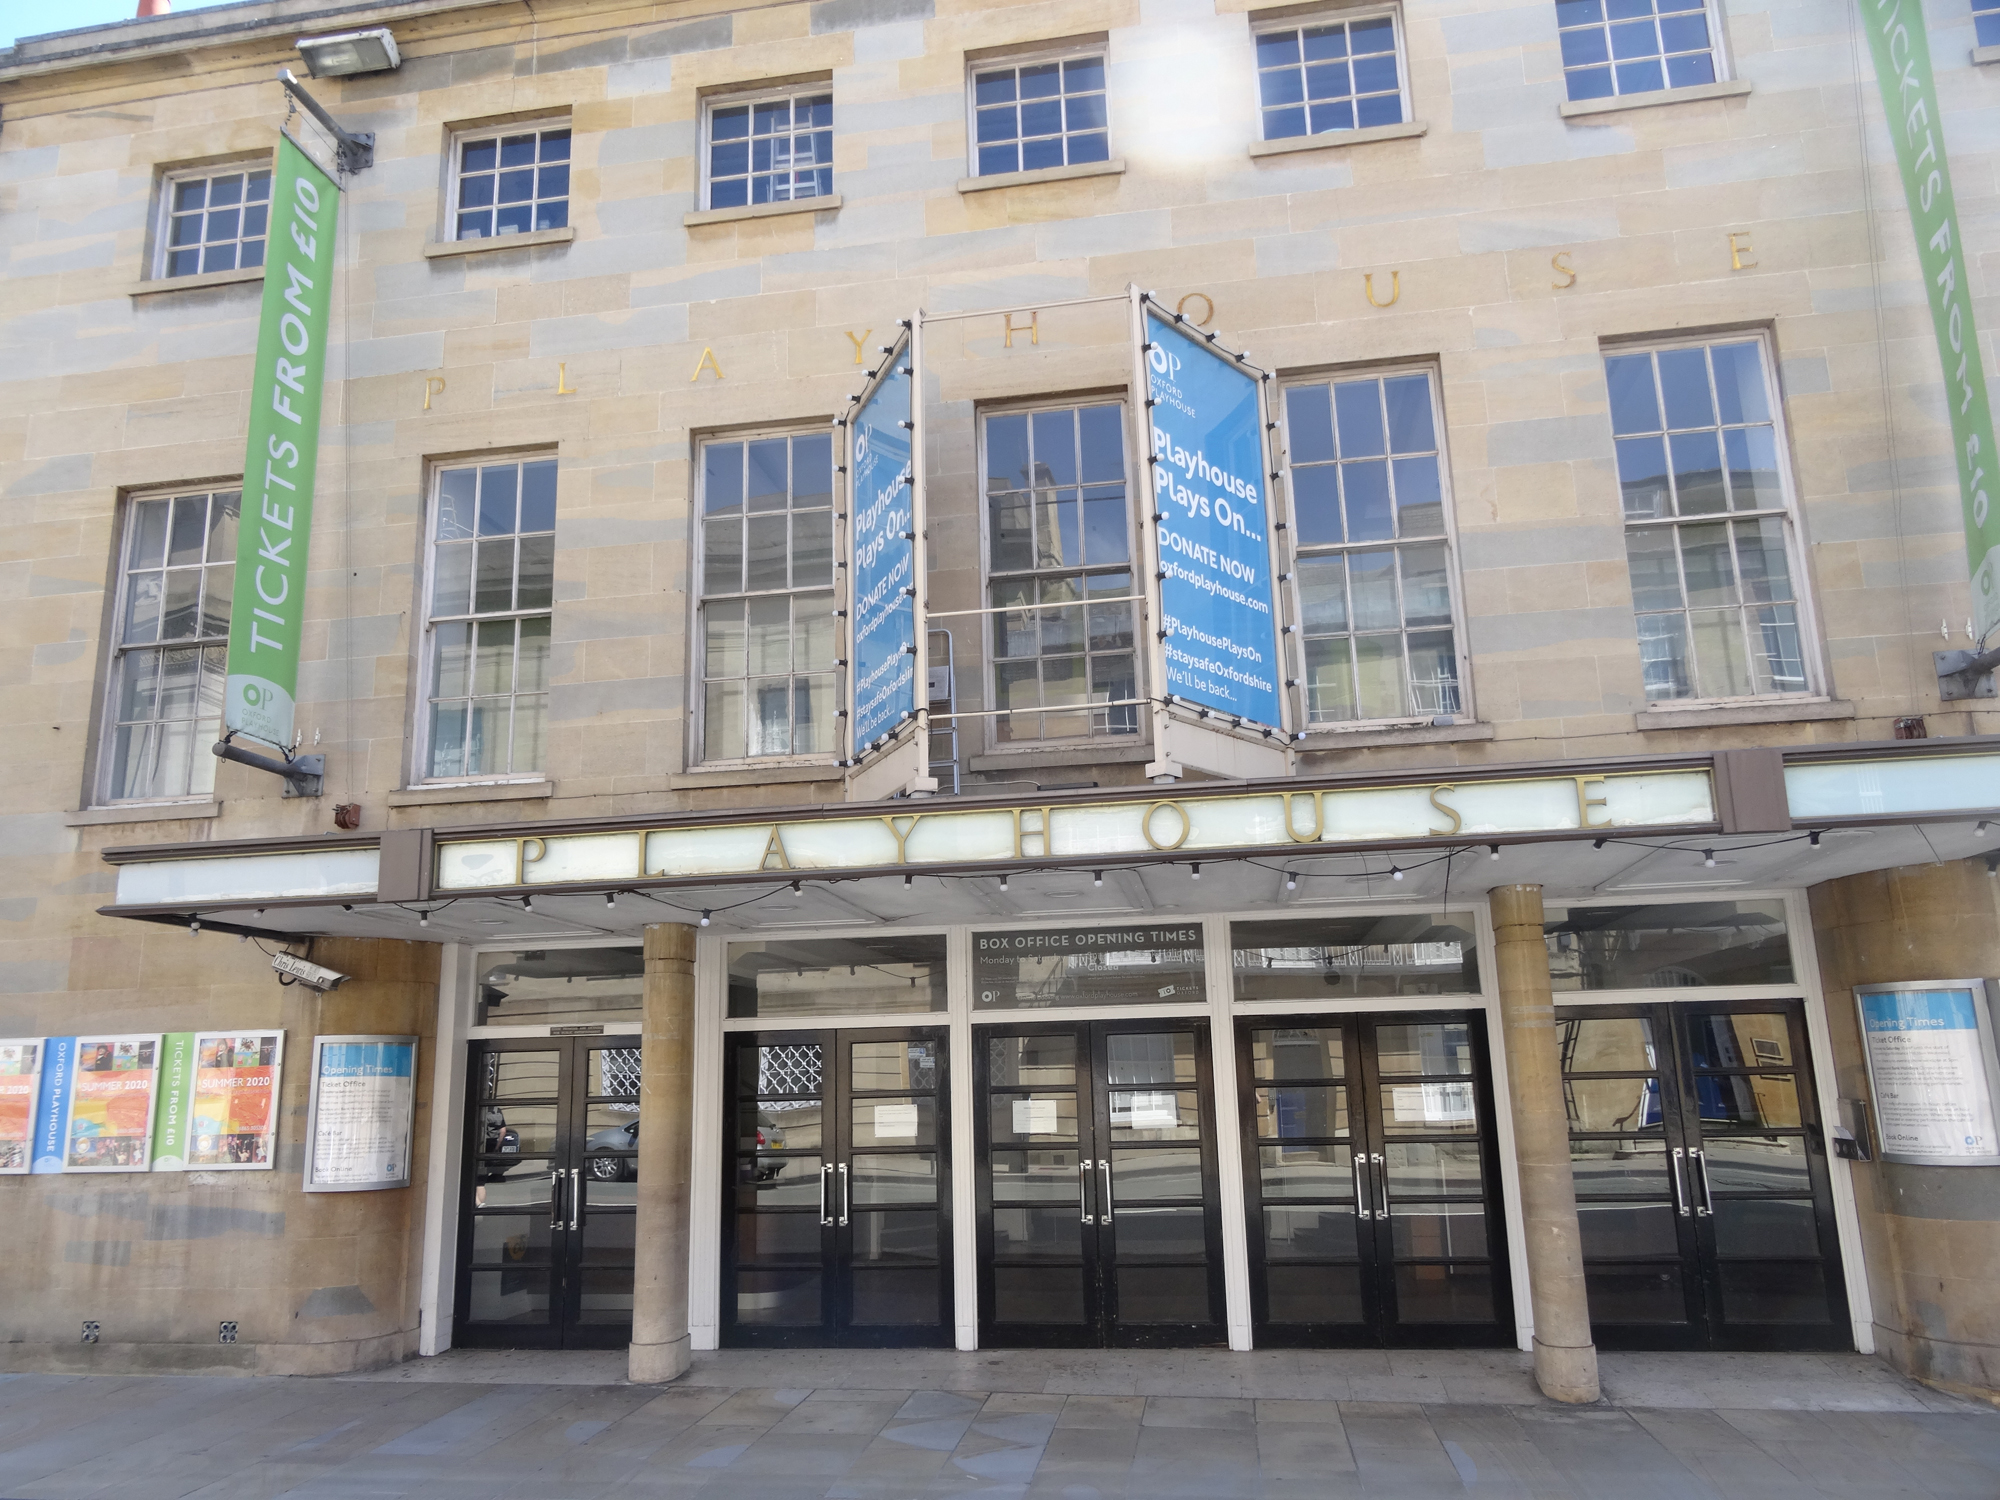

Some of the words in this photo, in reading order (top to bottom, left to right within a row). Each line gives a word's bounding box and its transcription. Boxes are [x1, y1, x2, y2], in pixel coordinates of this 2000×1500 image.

[290, 177, 320, 262] £10
[1877, 0, 1942, 213] ICKETS
[1929, 217, 1973, 415] FROM
[1966, 434, 1989, 528] £10
[423, 231, 1758, 410] PLAYHOUSE
[272, 261, 314, 425] FROM
[1150, 374, 1183, 398] OXFORD
[1151, 385, 1196, 418] PLAYHOUSE
[1153, 426, 1257, 504] Playhouse
[856, 460, 912, 541] Playhouse
[1155, 465, 1211, 519] Plays
[1214, 497, 1262, 542] On...
[250, 433, 299, 653] TICKETS
[856, 530, 885, 576] Plays
[1158, 526, 1218, 569] DONATE
[1220, 554, 1255, 585] NOW
[857, 575, 887, 621] DONATE
[888, 552, 910, 590] NOW
[1160, 560, 1269, 614] oxfordplayhouse.com
[1163, 613, 1262, 664] #PlayhousePlaysOn
[1164, 642, 1272, 693] #staysafeOxfordshire
[1166, 664, 1193, 688] We'll
[1194, 675, 1207, 692] be
[1208, 679, 1238, 702] back...
[241, 708, 272, 724] OXFORD
[241, 717, 280, 737] PLAYHOUSE
[870, 717, 877, 729] be
[515, 775, 1613, 886] PLAYHOUSE
[979, 937, 1010, 950] BOX
[1014, 934, 1070, 948] OFFICE
[1075, 931, 1145, 946] OPENING
[1150, 929, 1197, 942] TIMES
[273, 955, 289, 970] Chris
[980, 954, 1014, 965] Monday
[1087, 962, 1119, 972] Closed
[1869, 1017, 1907, 1030] Opening
[1906, 1016, 1945, 1027] Times
[1888, 1035, 1912, 1044] Office
[56, 1042, 67, 1086] OXFORD
[171, 1040, 185, 1087] TICKETS
[201, 1078, 244, 1089] SUMMER
[246, 1076, 270, 1087] 2020
[322, 1065, 364, 1076] Opening
[366, 1064, 393, 1074] Times
[81, 1081, 122, 1092] SUMMER
[124, 1080, 148, 1090] 2020
[343, 1080, 366, 1088] Office
[46, 1088, 62, 1152] PLAYHOUSE
[168, 1090, 180, 1127] FROM
[166, 1128, 176, 1146] £10
[1897, 1133, 1919, 1141] Online
